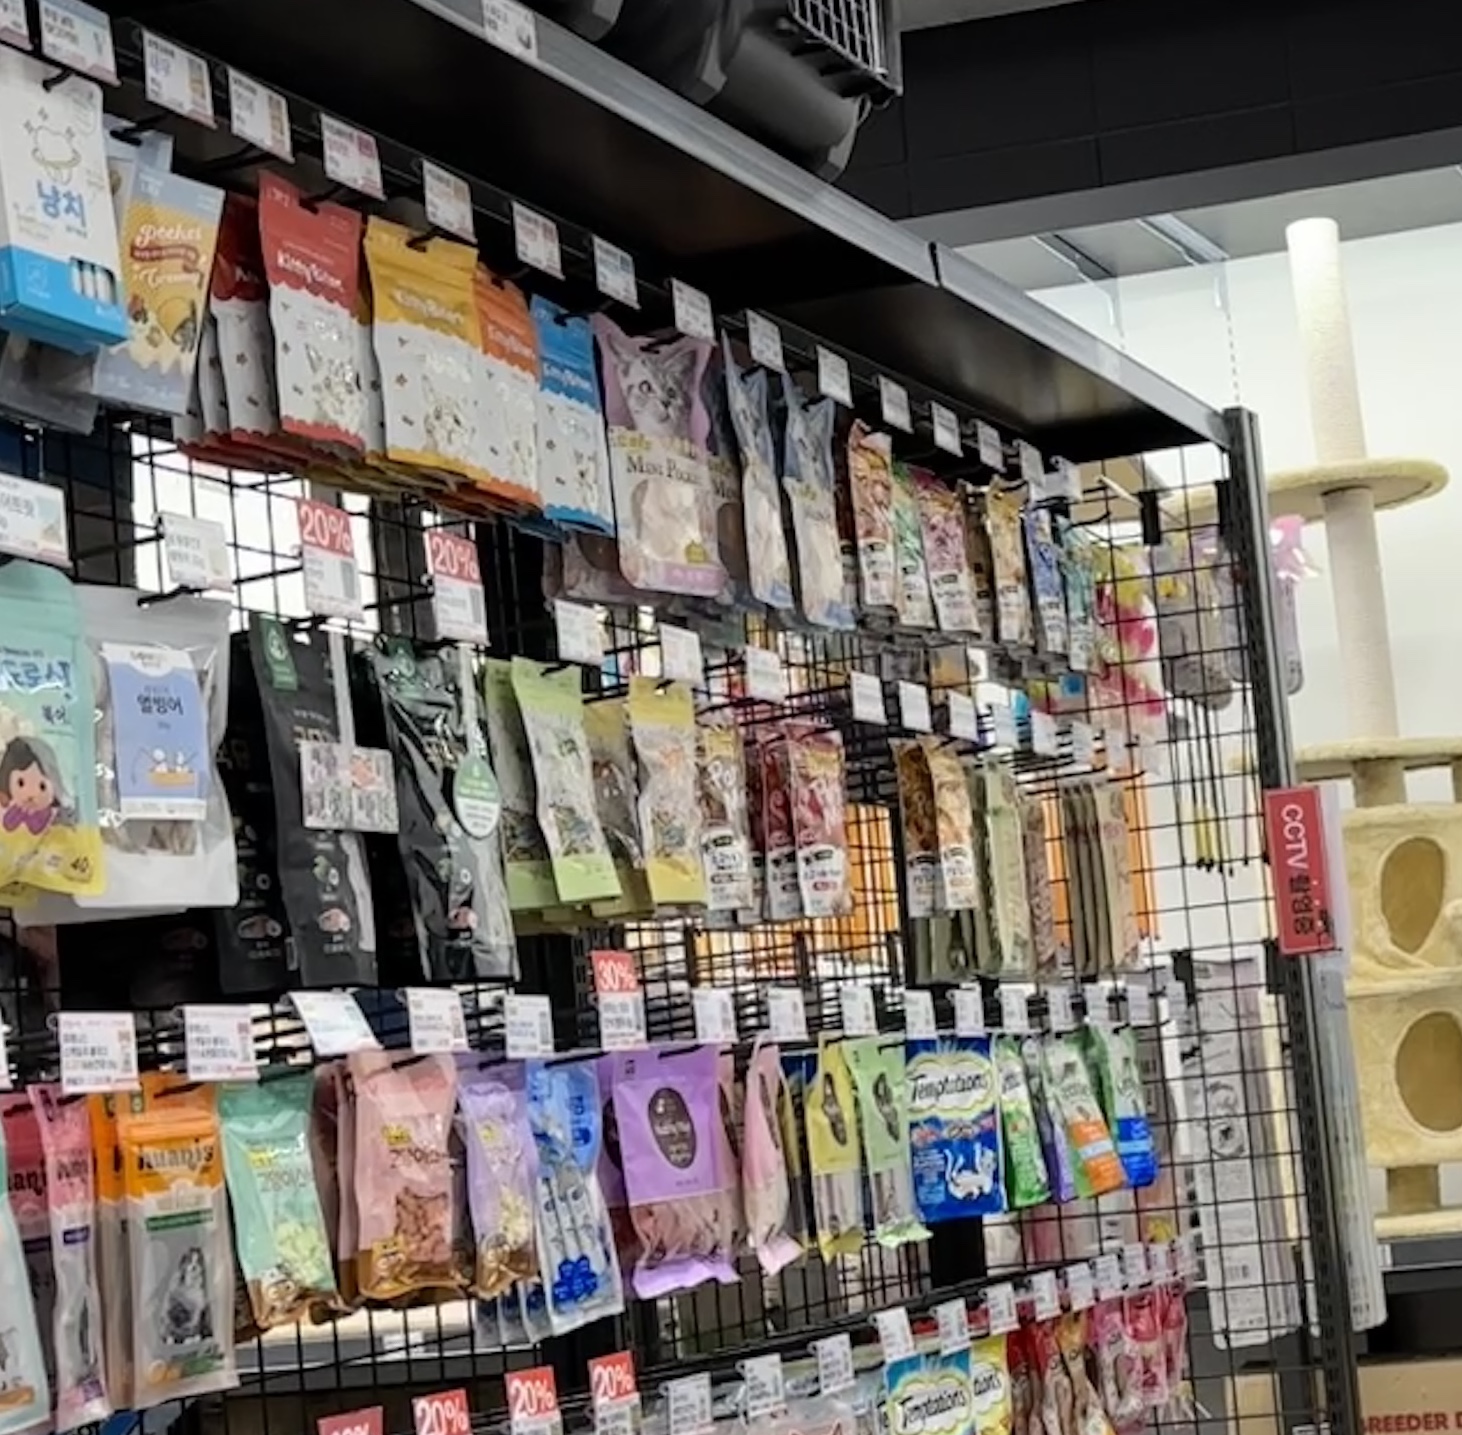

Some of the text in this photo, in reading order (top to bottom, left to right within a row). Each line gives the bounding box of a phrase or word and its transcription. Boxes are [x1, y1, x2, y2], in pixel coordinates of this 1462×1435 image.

[301, 504, 352, 554] 20%
[431, 535, 478, 581] 20%
[1281, 803, 1309, 870] CCTV
[597, 956, 636, 991] 30%
[509, 1374, 554, 1419] 20%
[593, 1363, 635, 1400] 20%
